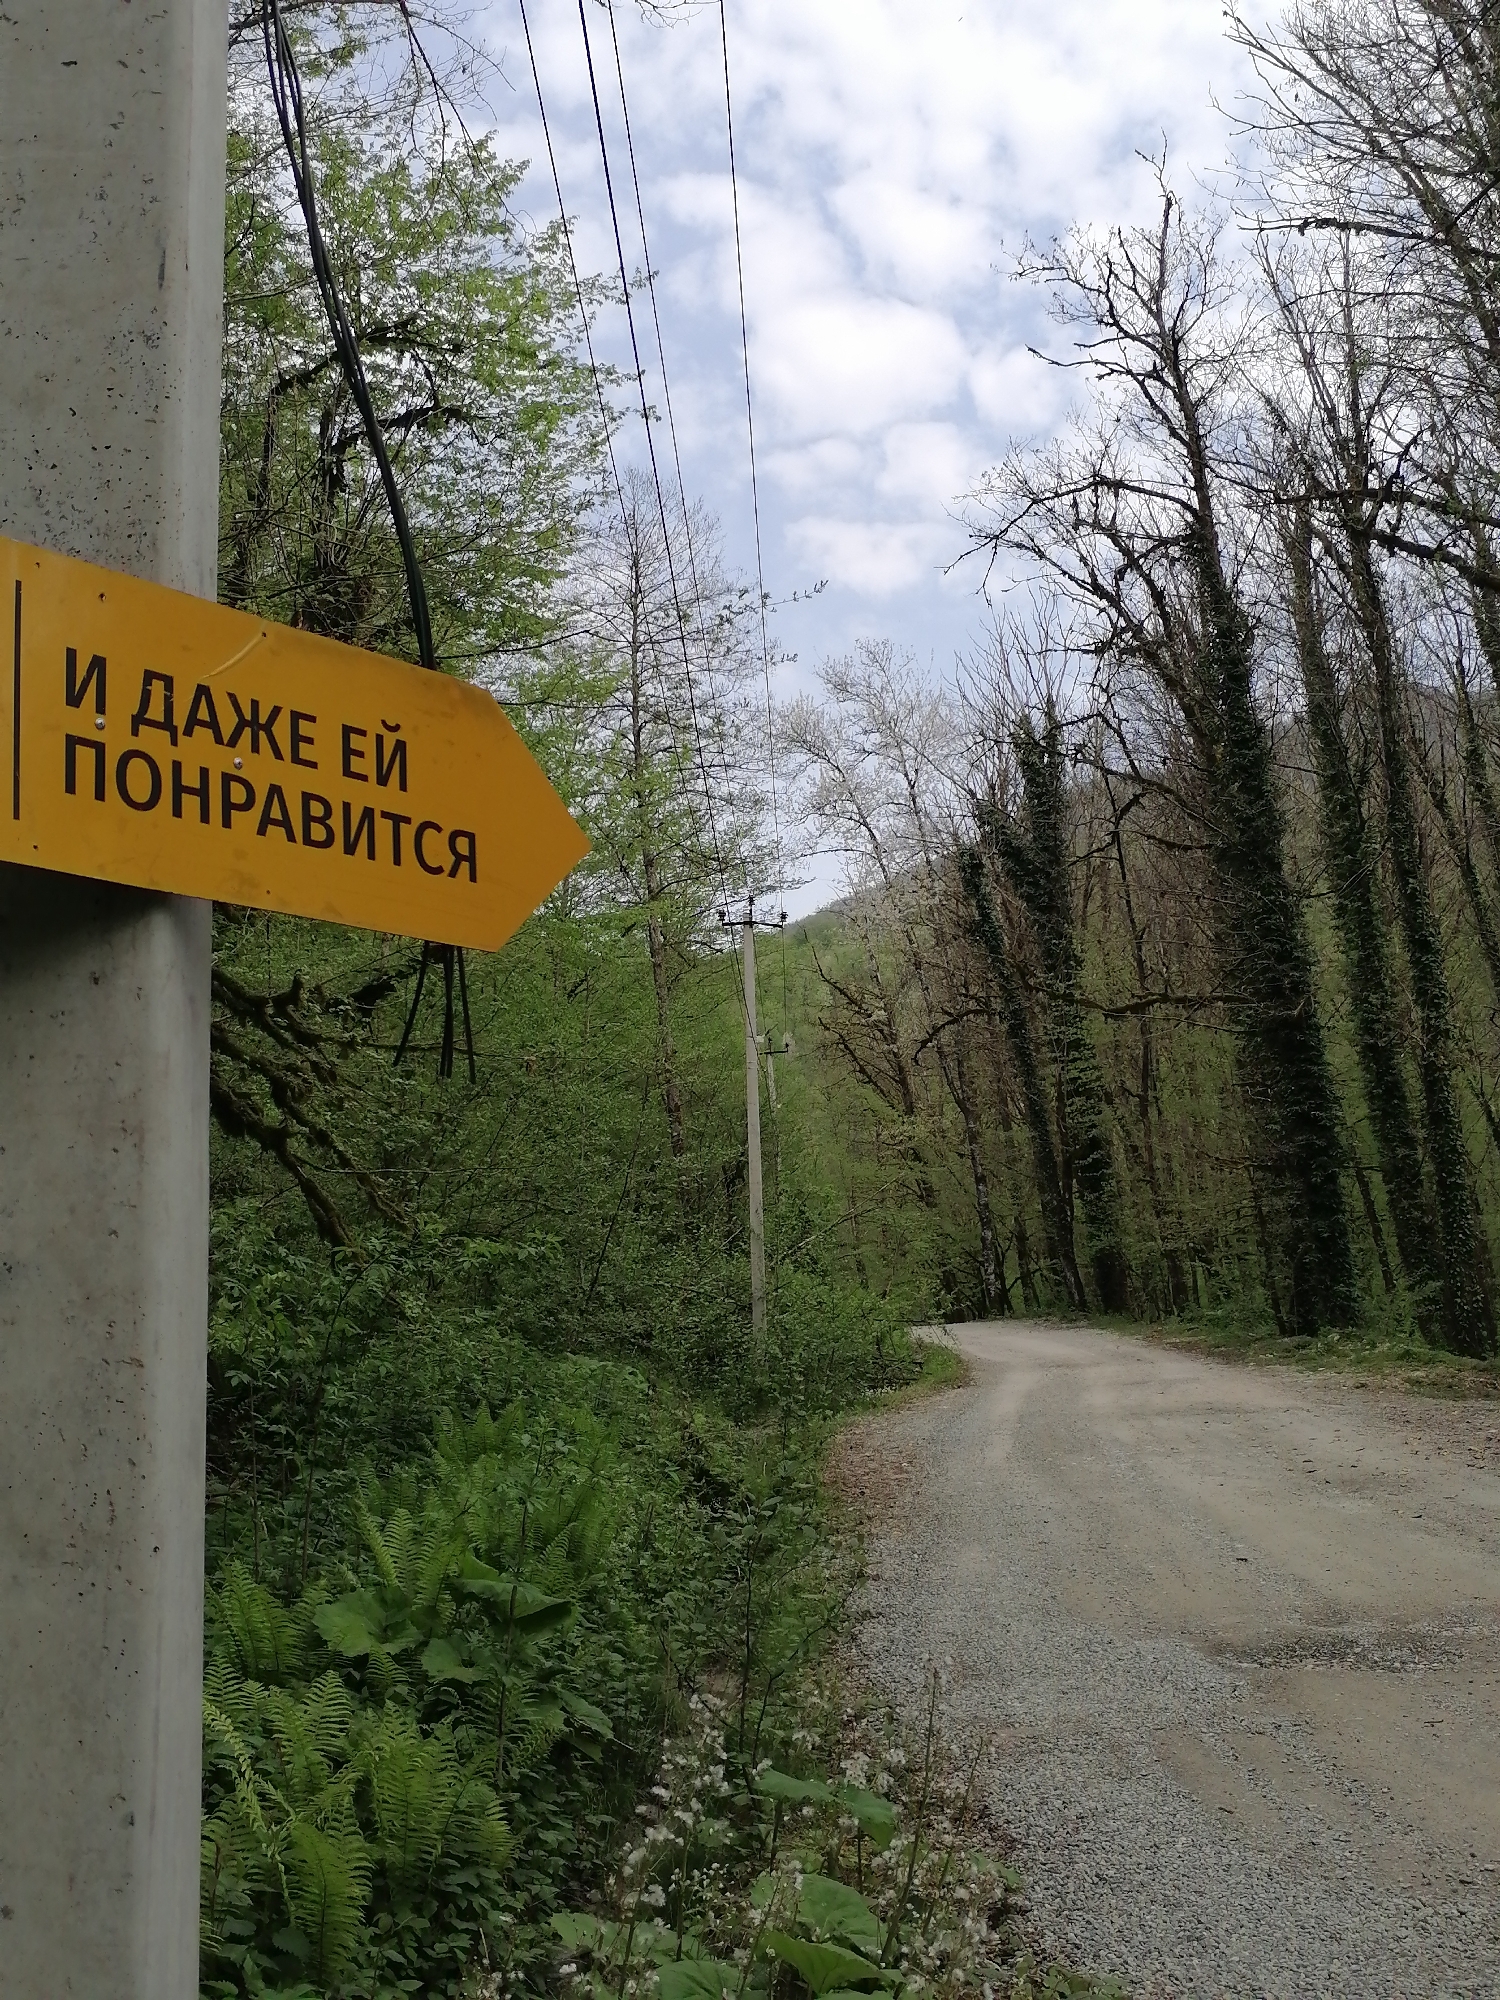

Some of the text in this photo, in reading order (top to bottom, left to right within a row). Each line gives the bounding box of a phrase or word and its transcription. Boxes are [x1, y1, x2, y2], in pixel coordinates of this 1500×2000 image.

[66, 647, 408, 793] И ДАЖЕ ЕЙ
[65, 733, 477, 883] ПОНРАВИТСЯ
